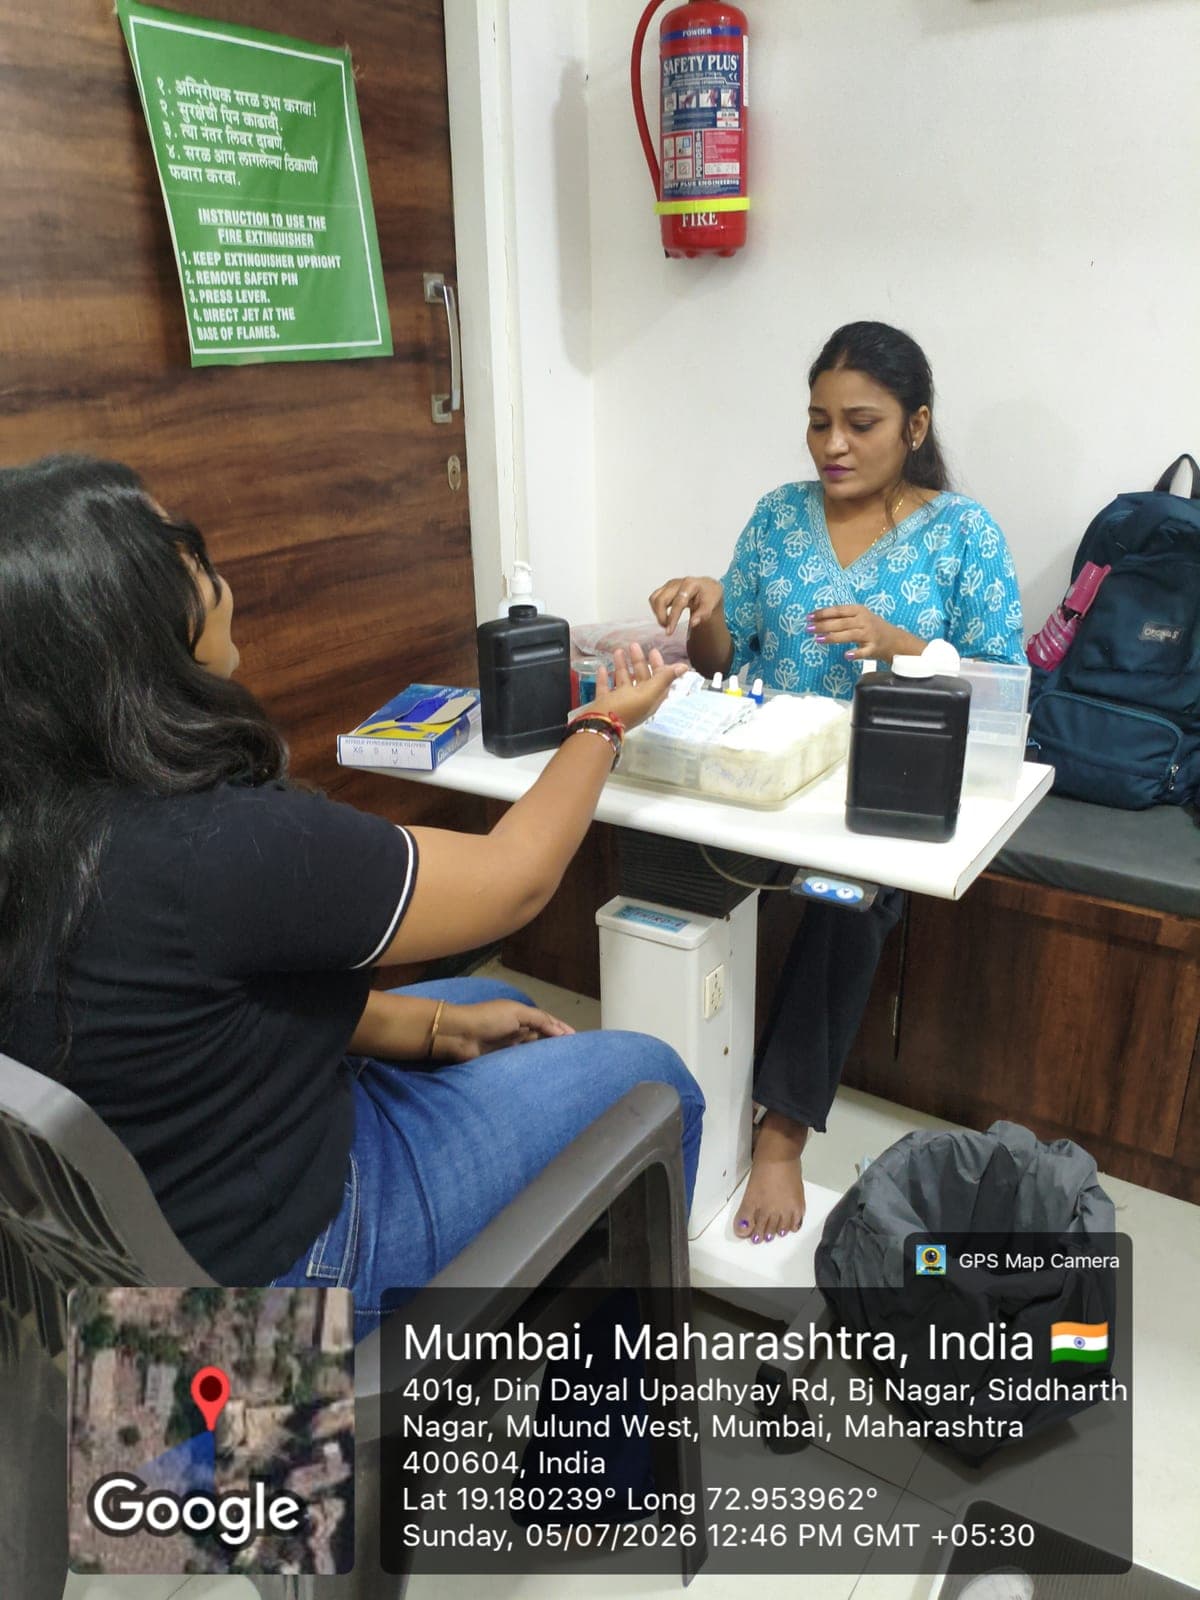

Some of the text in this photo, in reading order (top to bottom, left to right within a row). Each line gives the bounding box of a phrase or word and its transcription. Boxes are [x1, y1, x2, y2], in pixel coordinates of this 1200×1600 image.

[663, 54, 738, 76] SAFETY PLUS
[176, 76, 231, 103] अग्निरोधक
[220, 103, 240, 125] पिन
[180, 123, 198, 141] त्या
[200, 123, 223, 144] नंतर
[183, 145, 212, 163] सरळ
[214, 149, 236, 166] आग
[284, 152, 318, 174] ठिकाणी
[198, 208, 327, 230] INSTRUCTION TO USE THE
[682, 212, 718, 227] FIRE
[218, 228, 315, 247] FIRE EXTINGUISHER
[182, 252, 341, 269] 1. KEEP EXTINGUISHER UPRIGHT
[185, 271, 298, 286] 2. REMOVE SAFETY PIN
[189, 290, 270, 304] 3. PRESS LEVER.
[193, 307, 296, 322] 4. DIRECT JET AT THE
[197, 325, 280, 341] BASE OF FLAMES.
